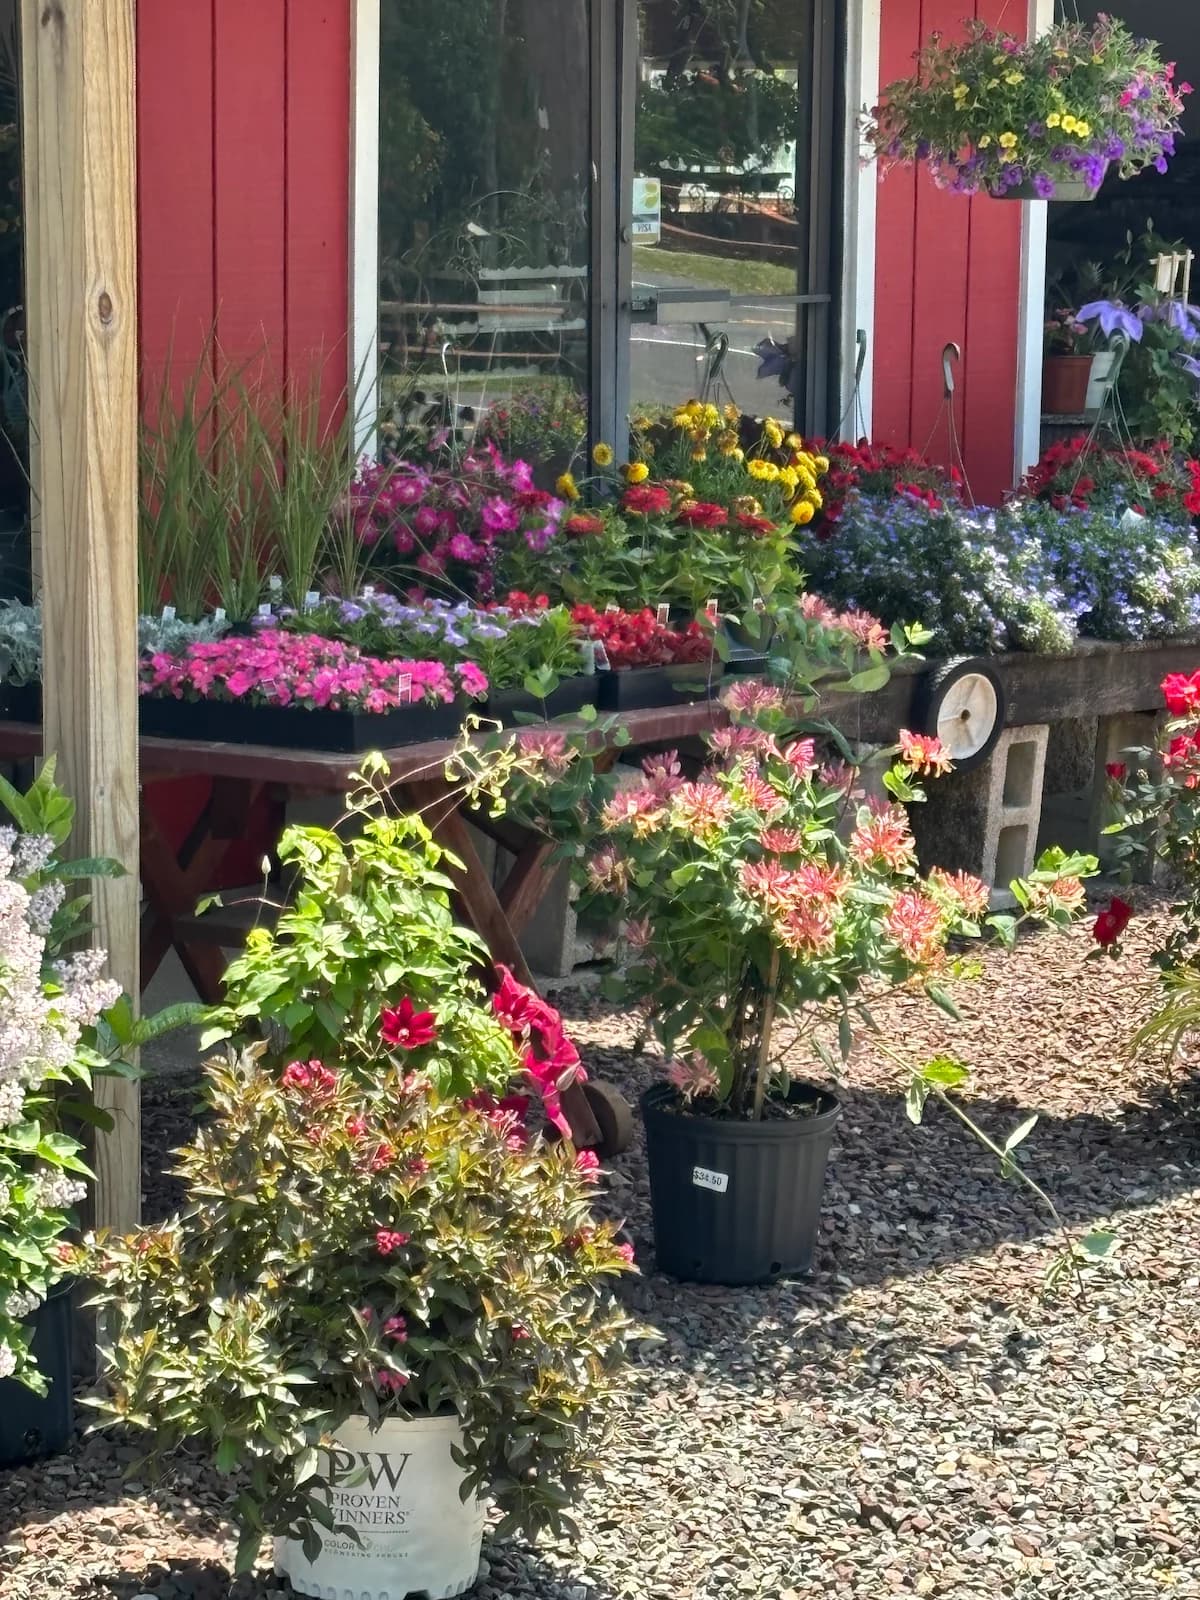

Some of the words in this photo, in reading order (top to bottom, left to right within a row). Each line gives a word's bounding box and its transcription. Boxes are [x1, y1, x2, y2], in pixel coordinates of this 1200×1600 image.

[637, 223, 652, 233] VISA
[693, 1170, 722, 1185] $34.50
[328, 1449, 413, 1492] PW
[332, 1493, 400, 1508] PROVEN
[324, 1539, 355, 1550] COLOR
